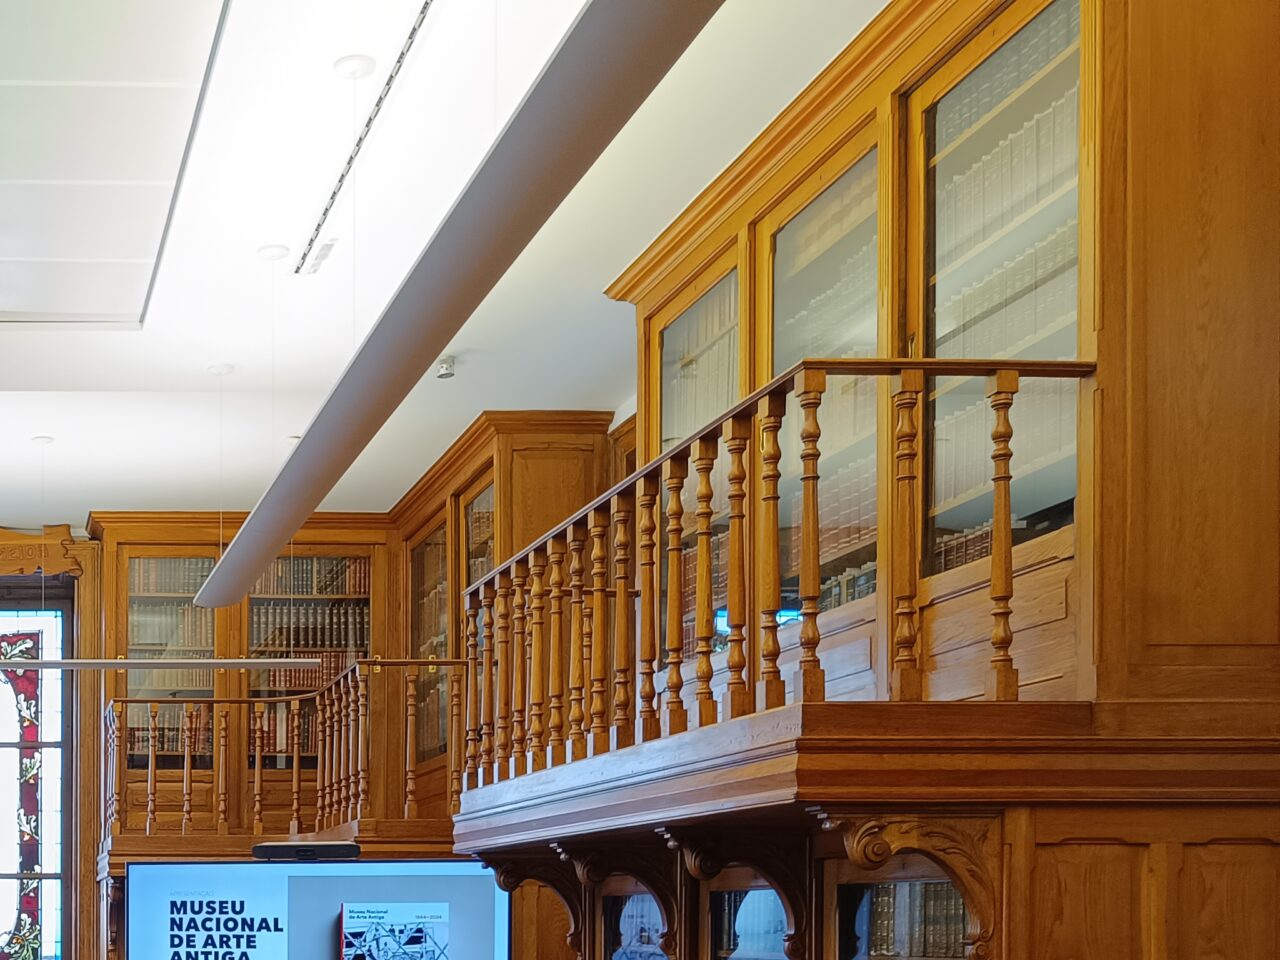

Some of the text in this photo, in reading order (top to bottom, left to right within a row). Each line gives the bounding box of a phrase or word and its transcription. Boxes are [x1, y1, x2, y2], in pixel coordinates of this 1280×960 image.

[169, 900, 245, 915] MUSEU
[169, 917, 284, 932] NACIONAL
[169, 934, 257, 949] DE ARTE
